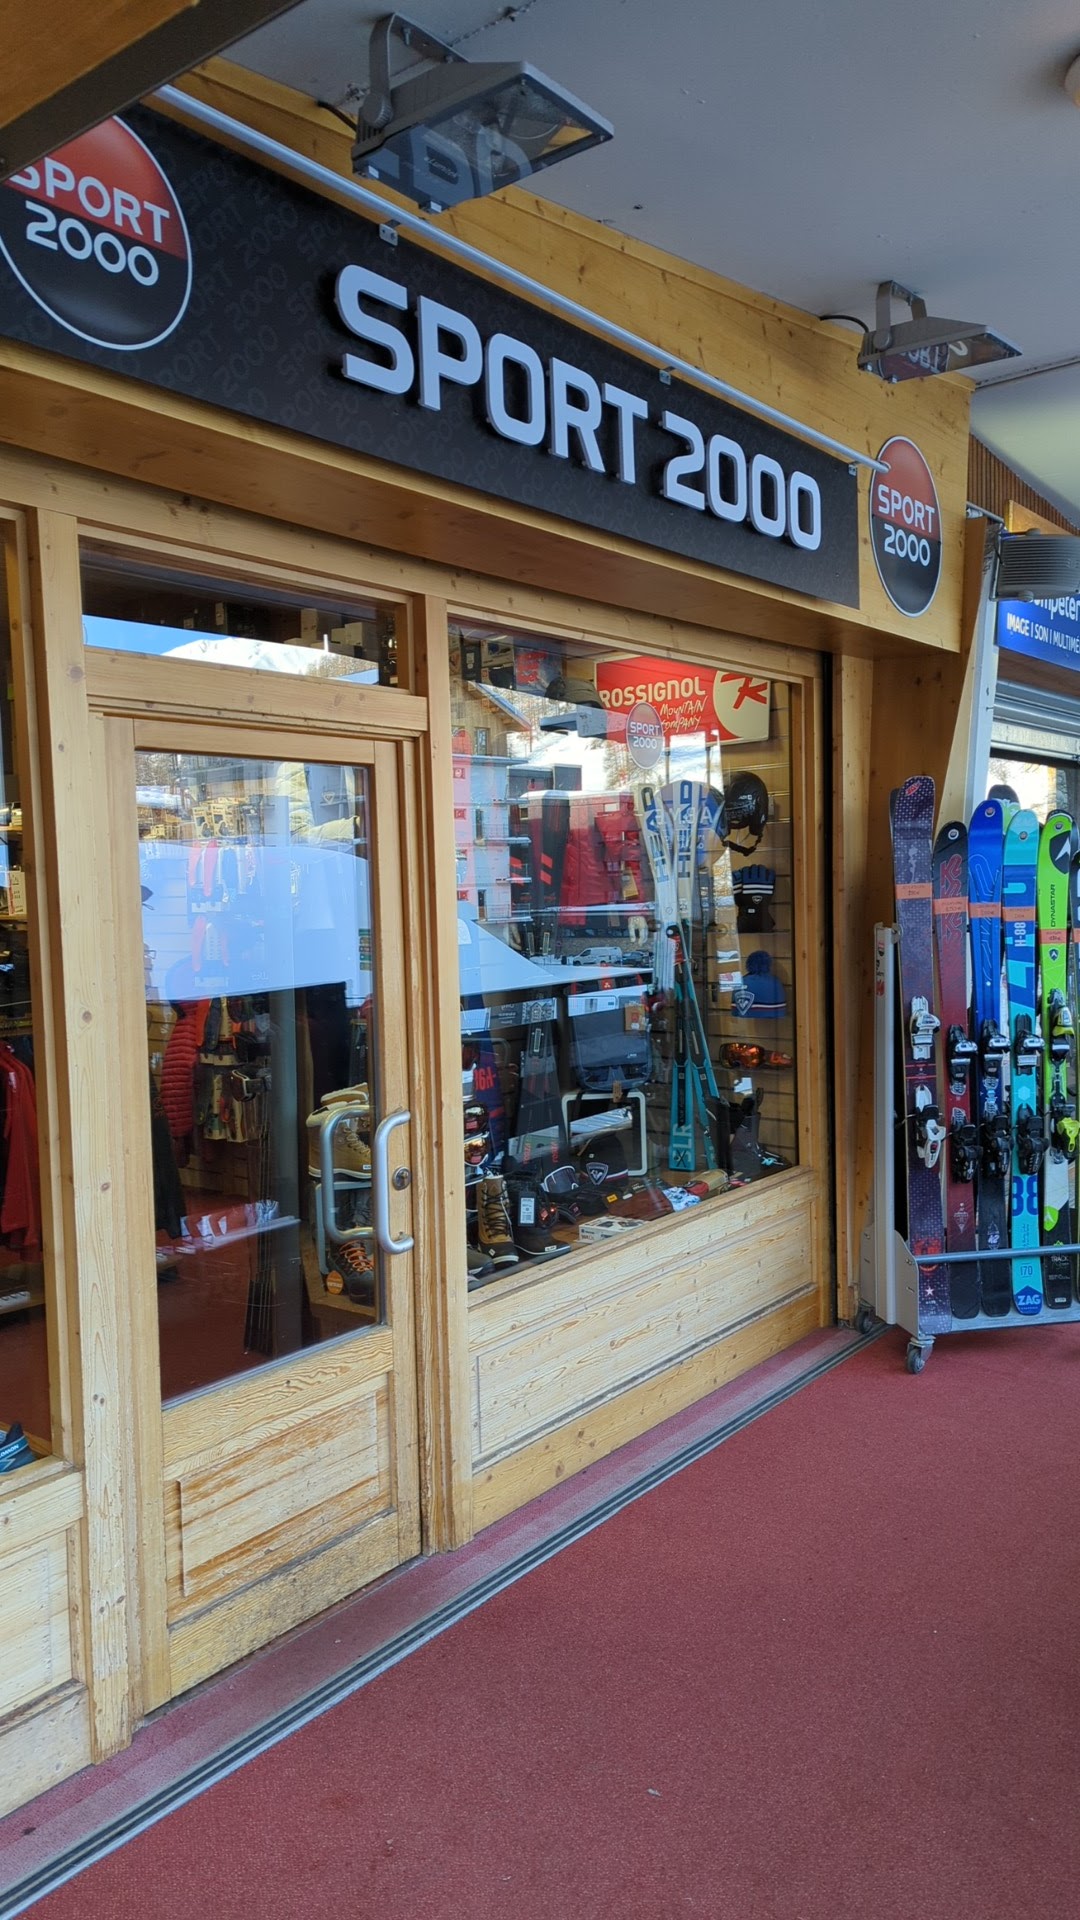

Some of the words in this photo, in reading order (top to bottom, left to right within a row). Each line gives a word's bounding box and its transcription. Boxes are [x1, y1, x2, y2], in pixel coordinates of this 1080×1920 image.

[25, 201, 160, 287] 2000
[337, 264, 648, 484] SPORT
[661, 410, 821, 550] 2000
[878, 484, 935, 533] SPORT
[884, 524, 931, 567] 2000
[1006, 612, 1030, 637] IMAGE
[1035, 623, 1049, 644] SON
[599, 676, 706, 709] ROSSIGNOL
[629, 721, 661, 737] SPORT
[632, 736, 657, 750] 2000
[1013, 921, 1026, 947] H-88
[1020, 1265, 1033, 1276] 170
[1017, 1294, 1041, 1306] ZAG
